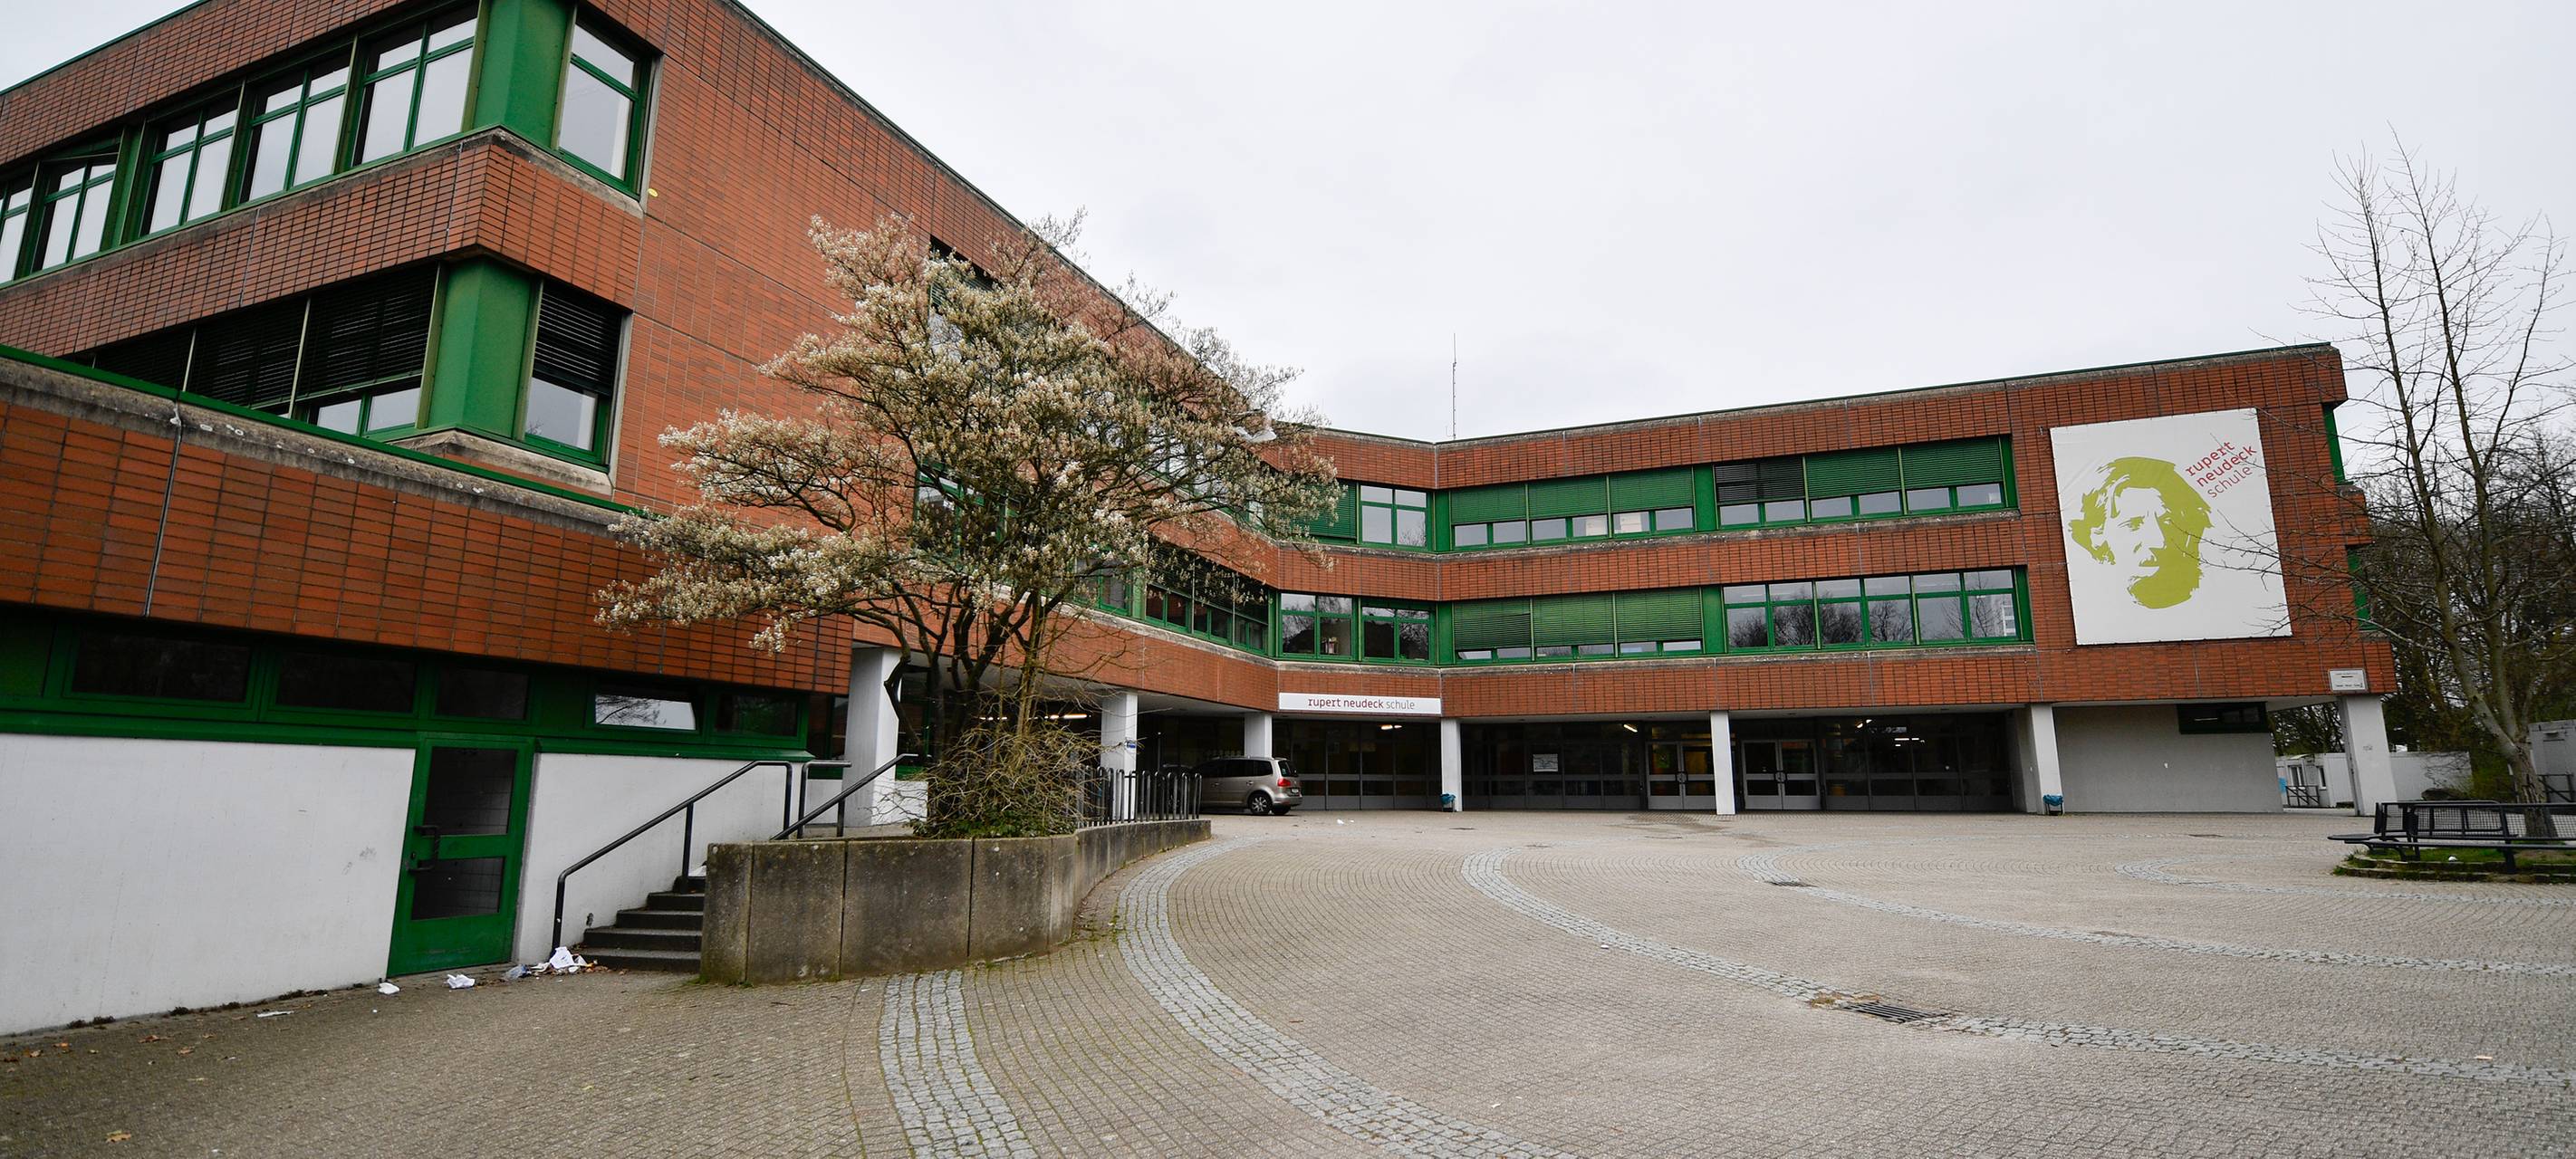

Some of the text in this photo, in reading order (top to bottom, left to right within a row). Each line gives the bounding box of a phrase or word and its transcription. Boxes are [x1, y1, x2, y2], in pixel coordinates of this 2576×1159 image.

[2186, 442, 2235, 476] rupert
[2196, 445, 2257, 487] neudeck
[2207, 466, 2253, 498] schule
[1308, 698, 1415, 710] rupert neudeck schule
